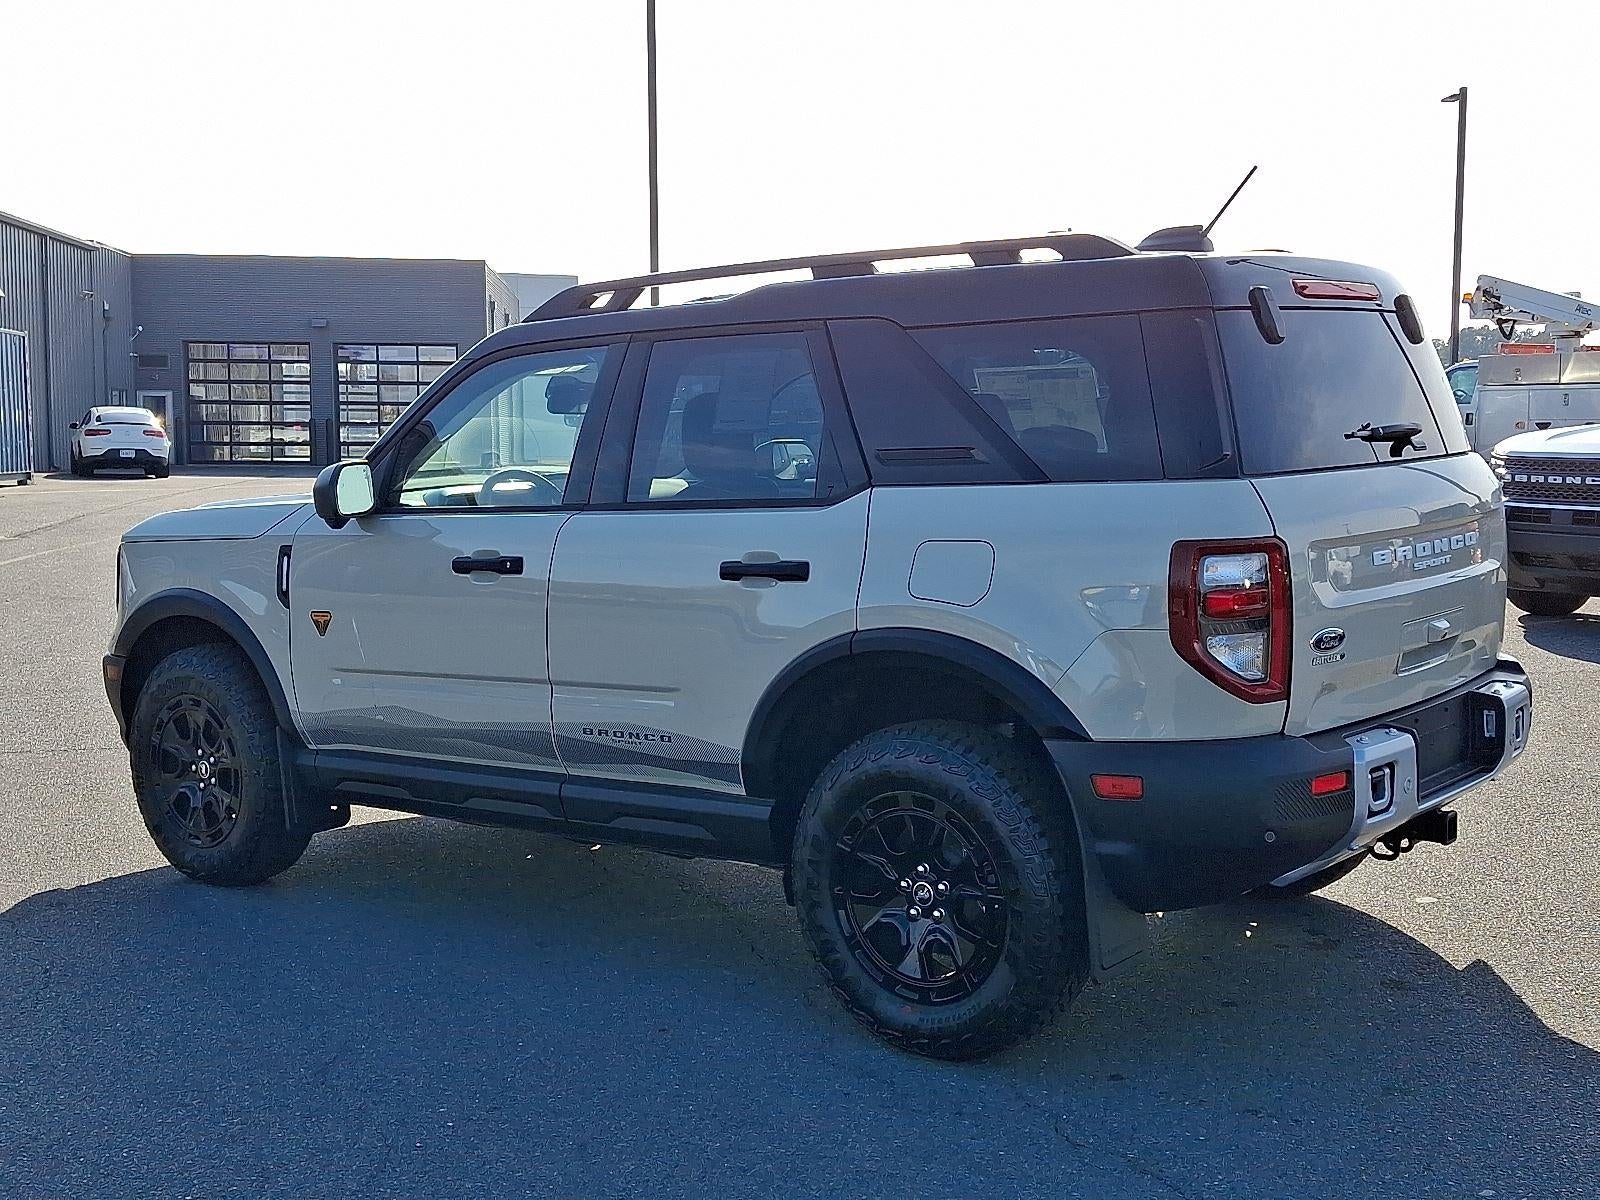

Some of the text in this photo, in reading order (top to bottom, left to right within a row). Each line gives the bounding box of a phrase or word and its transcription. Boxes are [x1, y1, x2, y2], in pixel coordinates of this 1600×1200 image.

[1372, 531, 1478, 566] BRONCO
[1413, 554, 1452, 571] SPORT
[582, 727, 673, 744] BRONCO
[611, 738, 643, 746] SPORT
